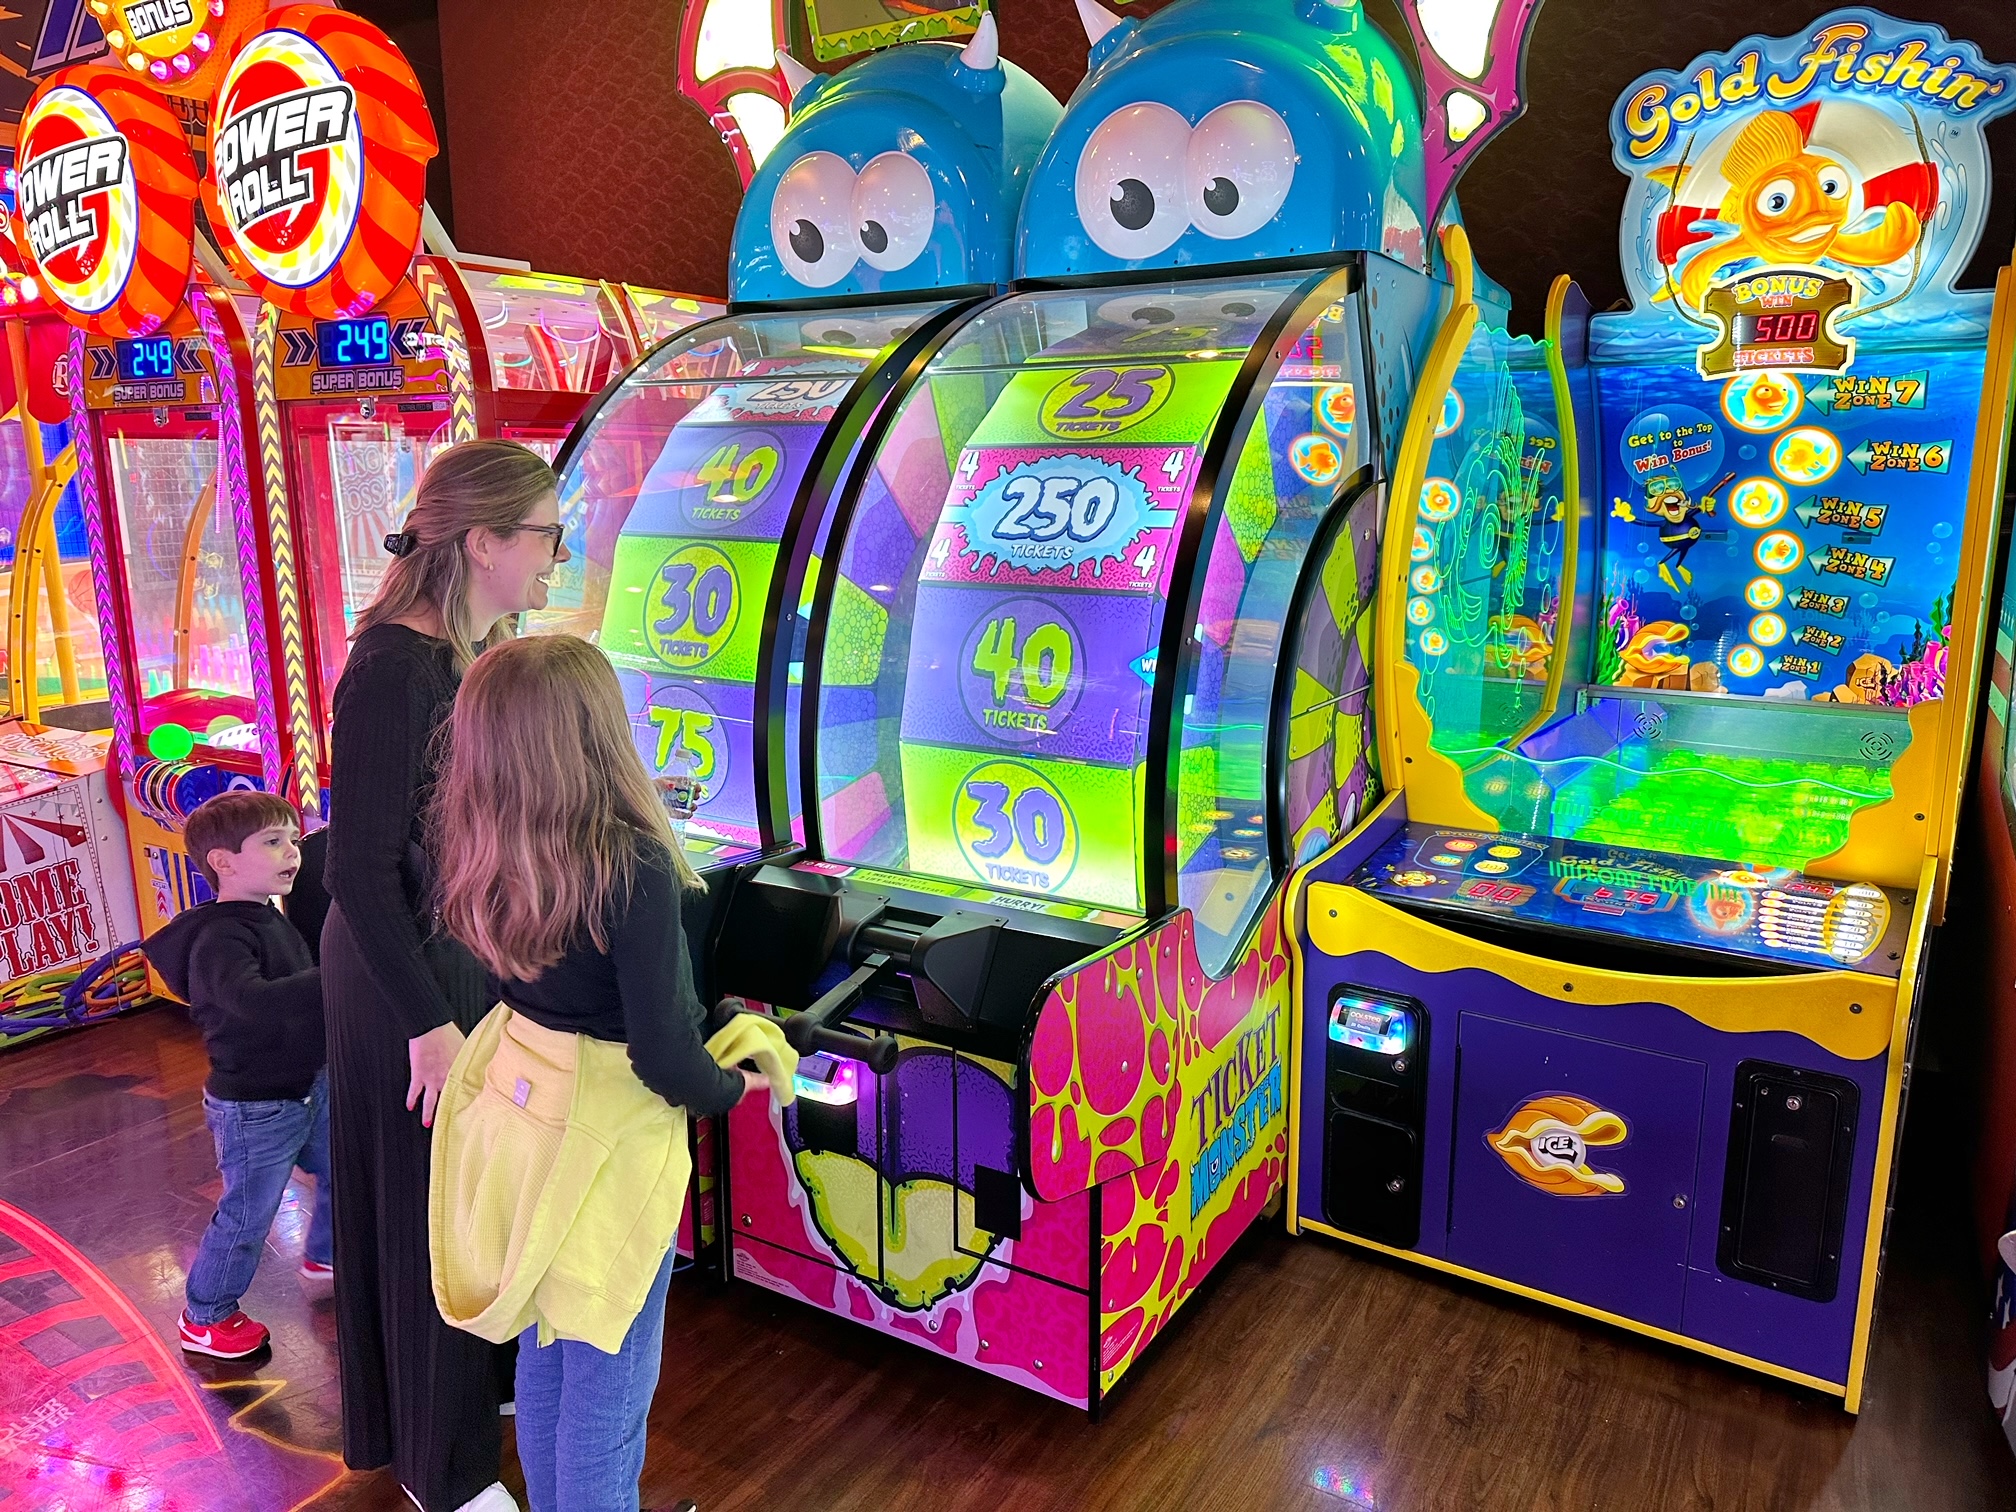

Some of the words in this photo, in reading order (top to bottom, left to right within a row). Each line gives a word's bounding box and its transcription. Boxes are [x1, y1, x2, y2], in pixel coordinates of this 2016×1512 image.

[128, 0, 192, 38] BONUS
[1625, 52, 1760, 157] Gold
[1766, 23, 2004, 108] Fishin'
[228, 157, 306, 224] ROLL
[29, 199, 93, 260] ROLL
[1736, 276, 1823, 302] BONUS
[1760, 294, 1793, 307] WIN
[1754, 314, 1817, 342] 500
[337, 321, 388, 362] 249
[132, 340, 173, 376] 249
[1734, 347, 1814, 366] TICKETS
[114, 385, 147, 400] SUPER
[149, 383, 185, 398] BONUS
[312, 373, 354, 391] SUPER
[358, 370, 402, 387] BONUS
[1833, 376, 1890, 394] WIN
[1053, 367, 1167, 420] 25
[1833, 393, 1892, 410] ZONE
[1895, 380, 1920, 405] 7
[755, 402, 804, 410] TICKETS
[1055, 420, 1121, 432] TICKETS
[1628, 433, 1654, 447] Get
[1659, 431, 1672, 441] to
[1676, 426, 1693, 437] the
[1696, 423, 1713, 433] Top
[1673, 439, 1683, 447] to
[1871, 440, 1920, 458] WIN
[960, 451, 980, 481] 4
[1161, 450, 1185, 482] 4
[1634, 454, 1668, 473] Win
[1672, 440, 1712, 462] Bonus!
[1869, 455, 1920, 471] ZONE
[1924, 445, 1943, 467] 6
[696, 443, 778, 507] 40
[691, 508, 742, 521] TICKETS
[992, 475, 1120, 543] 250
[1821, 497, 1863, 516] WIN
[1817, 509, 1861, 529] ZONE
[1864, 508, 1882, 528] 5
[930, 538, 952, 568] 4
[1011, 544, 1074, 560] TICKETS
[1132, 545, 1157, 578] 4
[1830, 547, 1869, 567] WIN
[1825, 558, 1866, 579] ZONE
[1870, 559, 1886, 580] 4
[1128, 581, 1152, 589] TICKETS
[1803, 589, 1830, 604] WIN
[653, 564, 734, 637] 30
[1798, 598, 1828, 613] ZONE
[1831, 598, 1845, 613] 3
[1802, 633, 1828, 648] ZONE
[1830, 635, 1842, 648] 2
[1806, 625, 1830, 640] WIN
[660, 639, 709, 659] TICKETS
[970, 616, 1074, 707] 40
[1781, 662, 1807, 674] ZONE
[1809, 661, 1819, 673] 1
[1783, 655, 1808, 667] WIN
[1855, 677, 1876, 689] ICE
[982, 708, 1048, 731] TICKETS
[649, 704, 716, 782] 75
[965, 780, 1065, 866] 30
[1559, 855, 1614, 868] Gold
[985, 864, 1050, 888] TICKETS
[1783, 883, 1835, 896] 1247
[994, 896, 1046, 911] HURRY!
[0, 905, 98, 979] LAY!
[1190, 1000, 1281, 1156] TICKET
[1189, 1057, 1282, 1222] MONSTER
[1538, 1135, 1578, 1165] ICE
